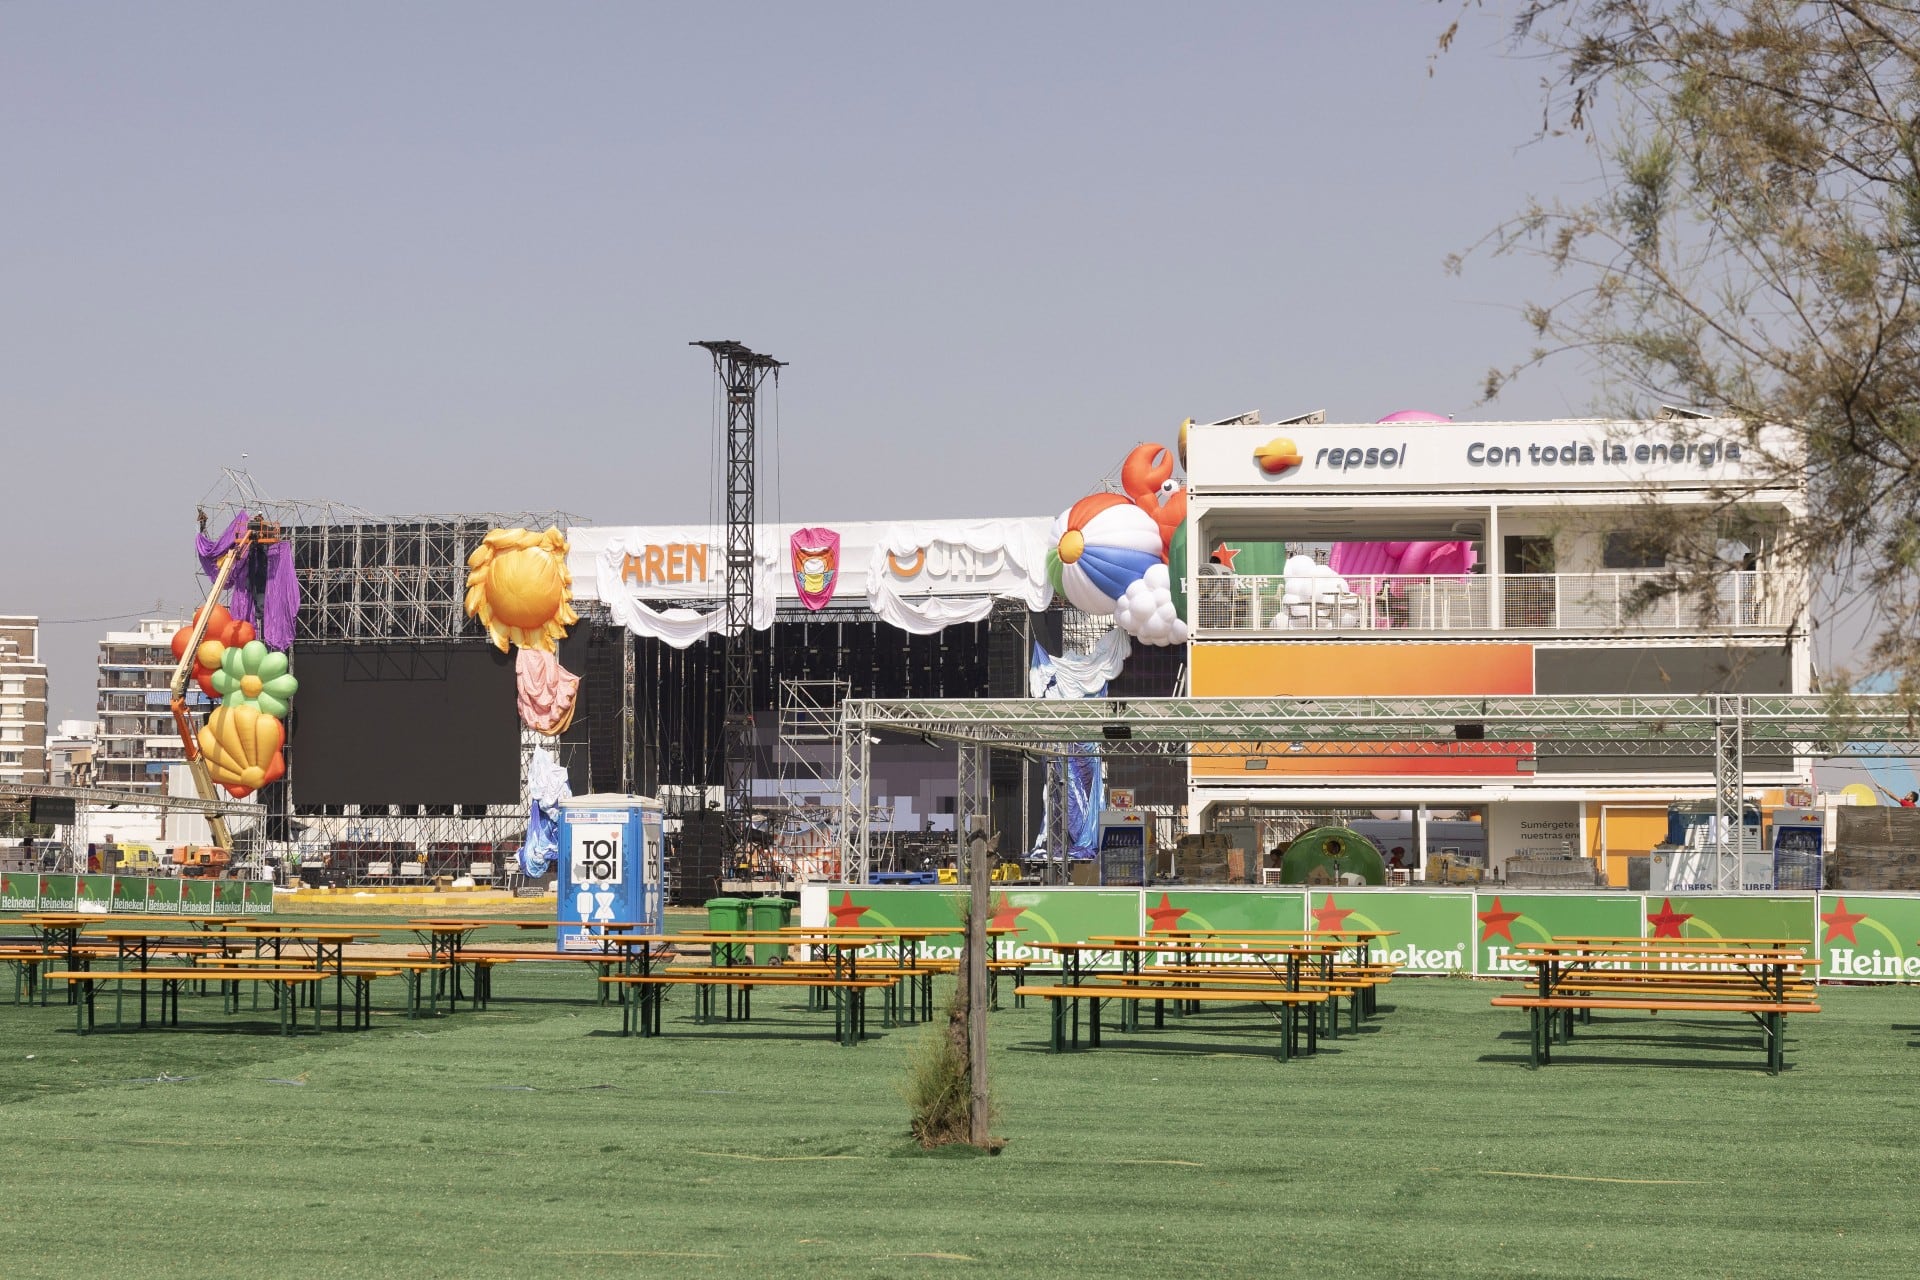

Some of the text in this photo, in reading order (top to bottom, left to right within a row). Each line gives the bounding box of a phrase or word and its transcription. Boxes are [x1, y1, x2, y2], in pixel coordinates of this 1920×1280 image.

[1316, 443, 1406, 470] repsol
[1467, 438, 1741, 466] Con toda la energía
[1521, 821, 1574, 830] Sumérgete
[583, 840, 617, 859] TOI
[583, 861, 617, 880] TOI
[2, 896, 36, 908] Heineken
